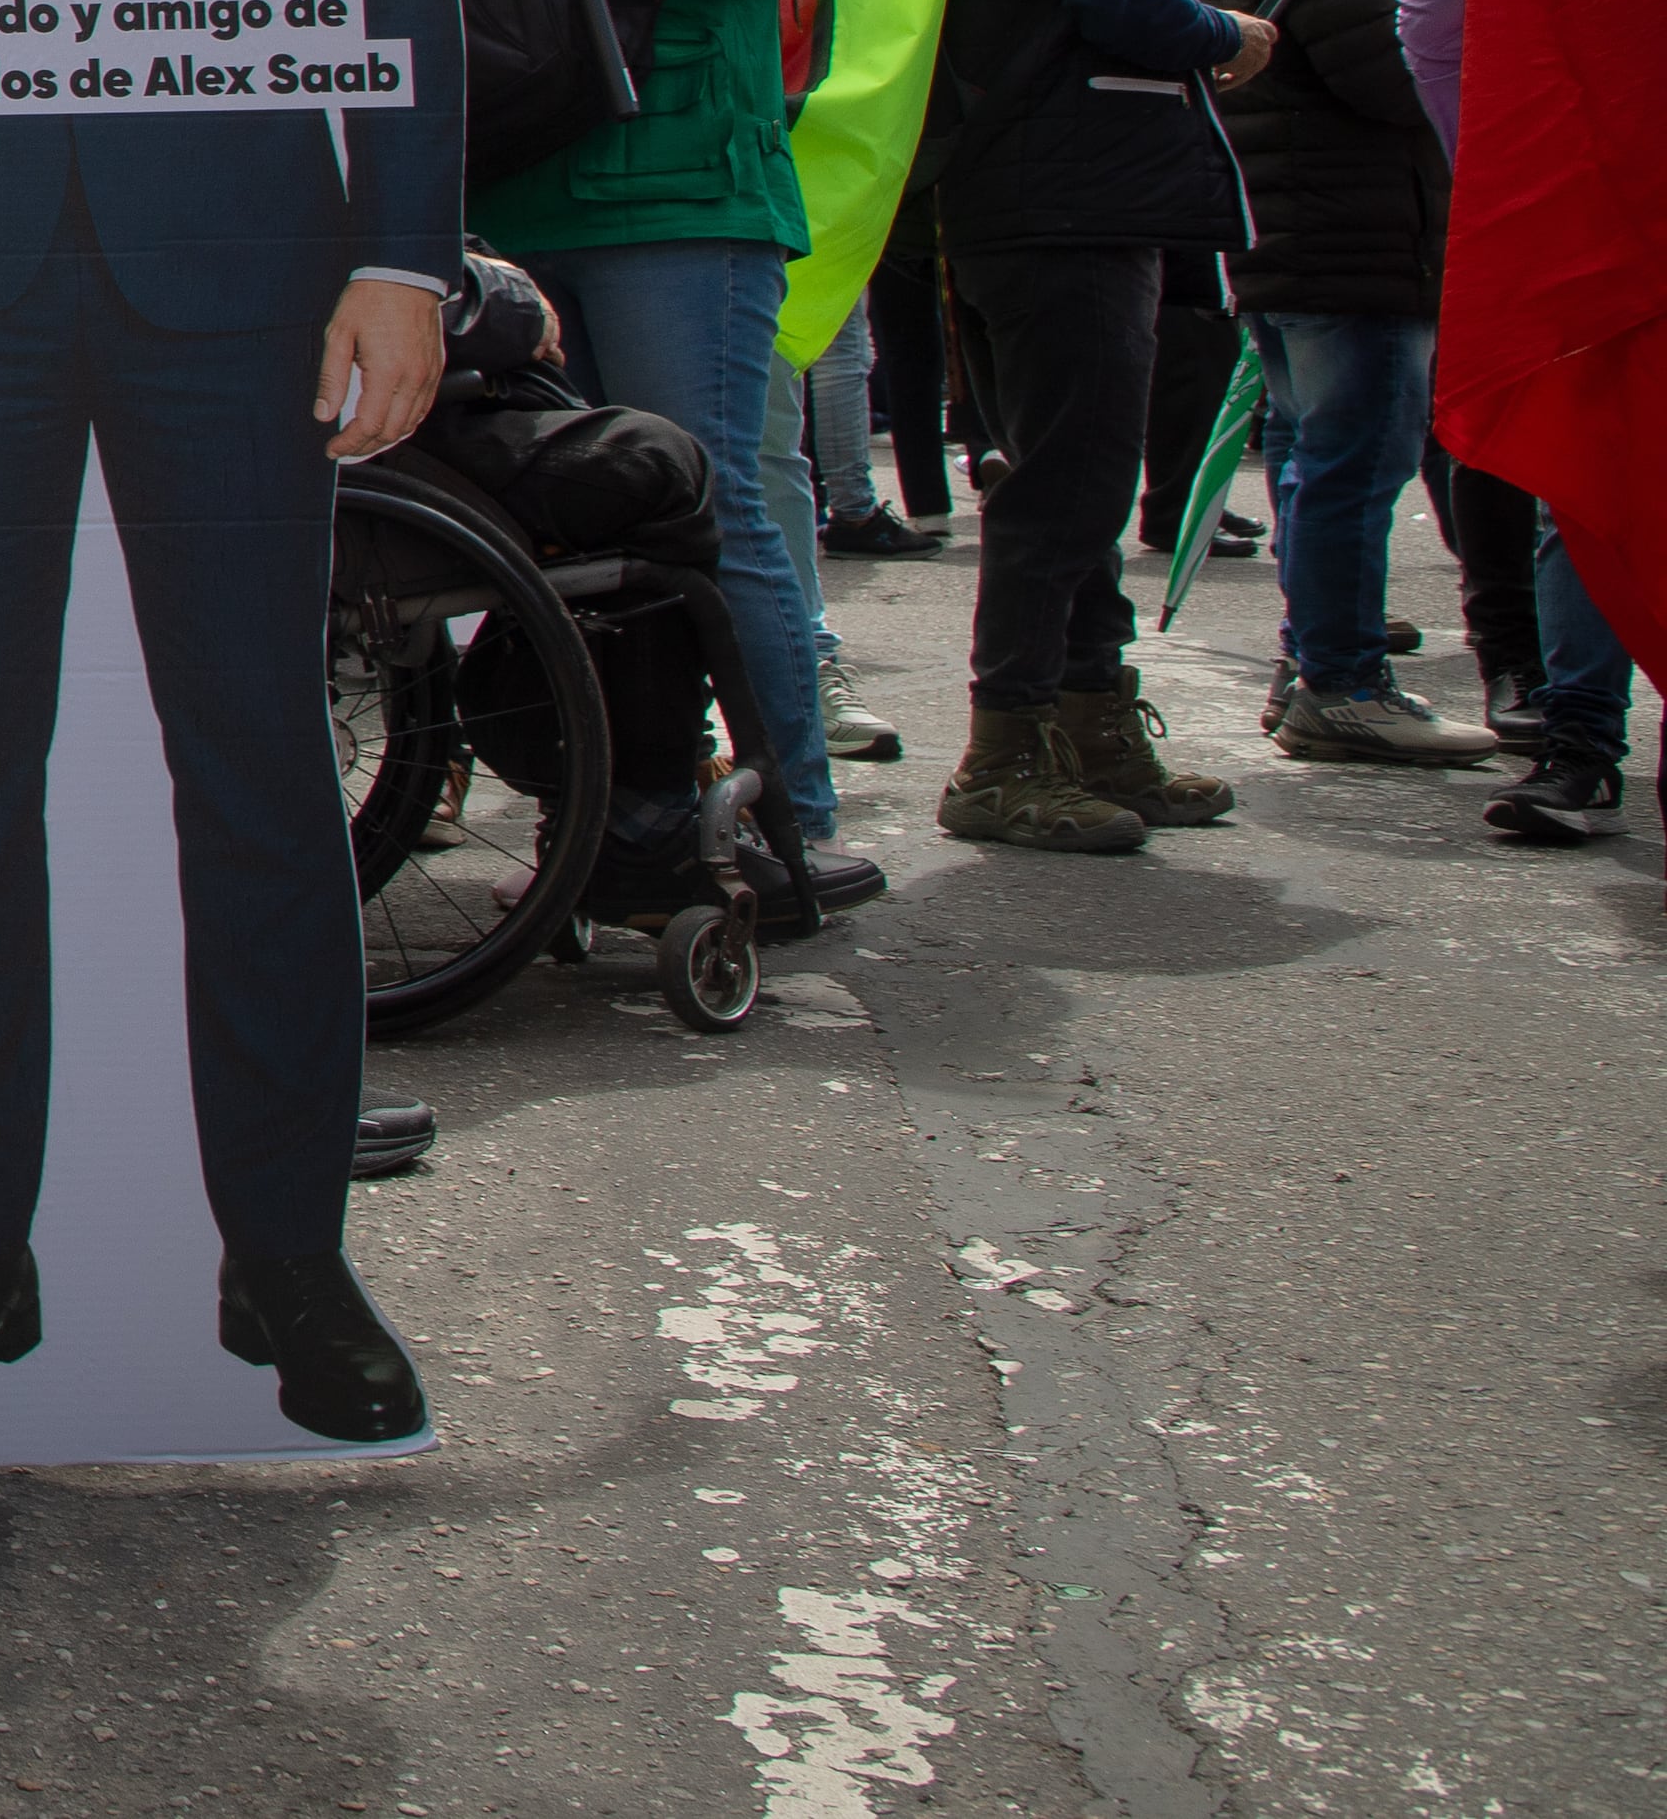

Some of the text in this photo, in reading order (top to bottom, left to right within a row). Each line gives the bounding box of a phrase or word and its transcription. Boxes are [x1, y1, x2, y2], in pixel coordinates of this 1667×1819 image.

[71, 2, 102, 43] y
[69, 59, 133, 99] de
[144, 55, 256, 97] Alex
[267, 53, 401, 95] Saab
